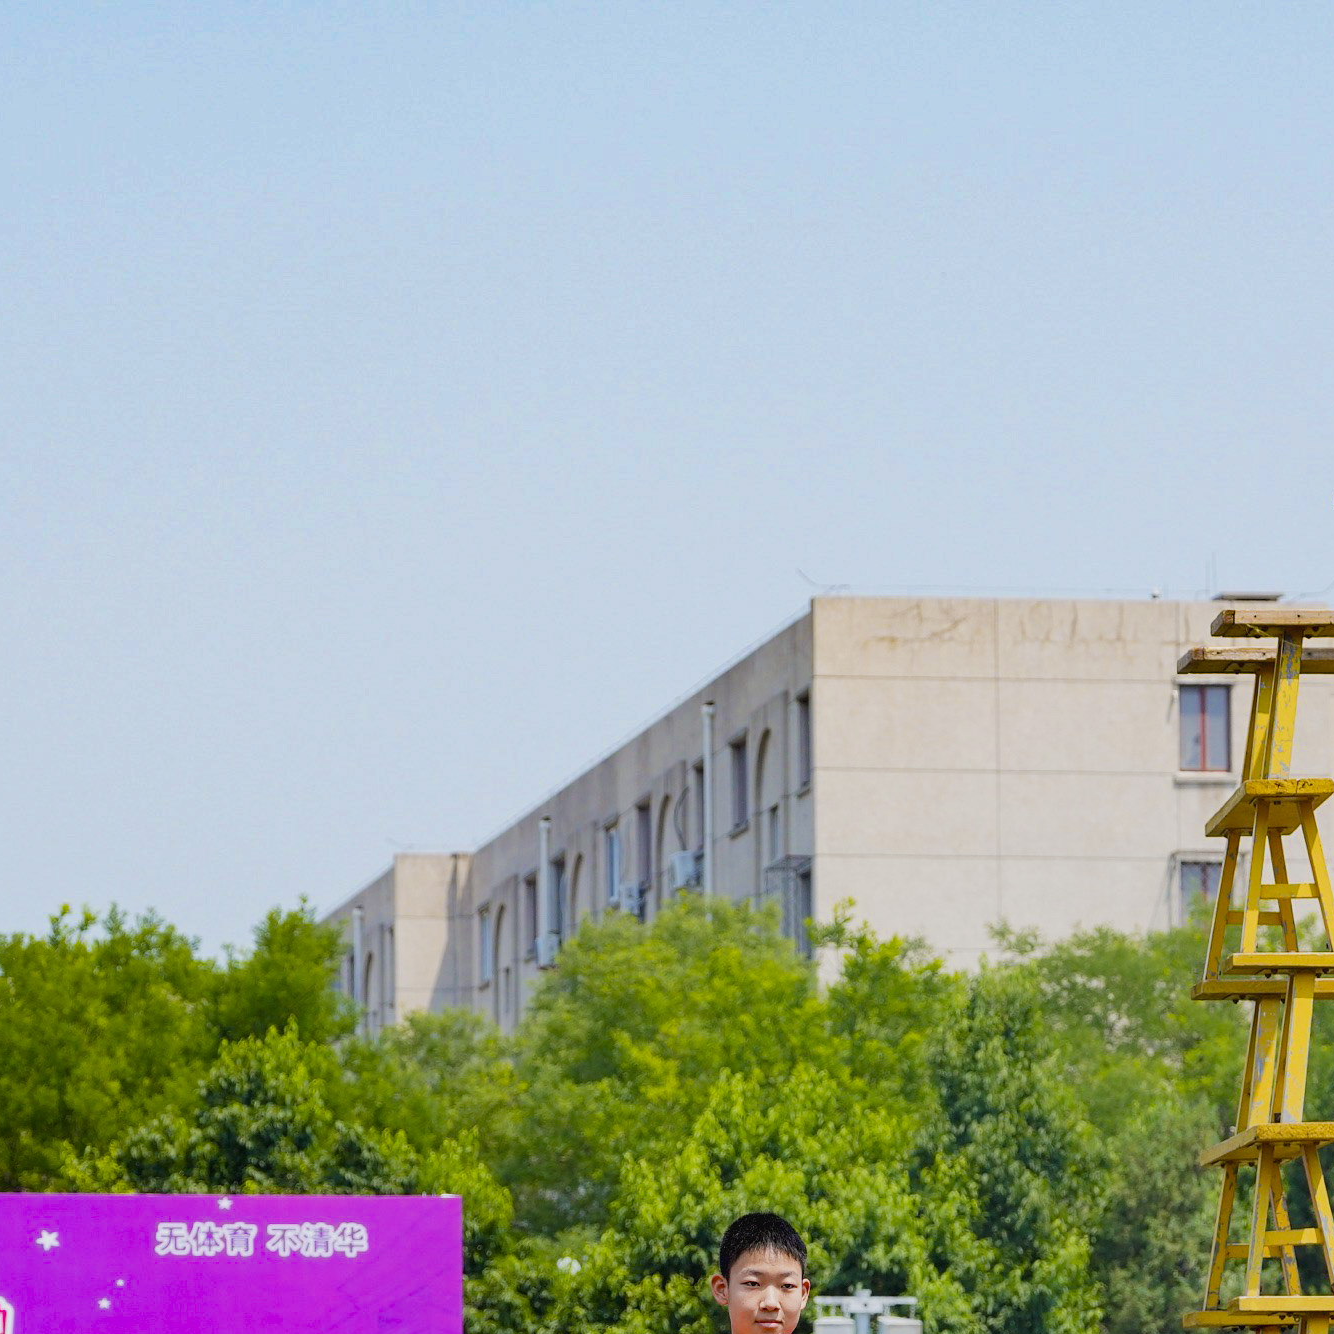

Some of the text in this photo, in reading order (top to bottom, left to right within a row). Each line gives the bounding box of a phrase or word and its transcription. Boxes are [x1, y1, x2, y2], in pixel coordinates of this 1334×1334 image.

[155, 1222, 369, 1258] 无体育 不清华
